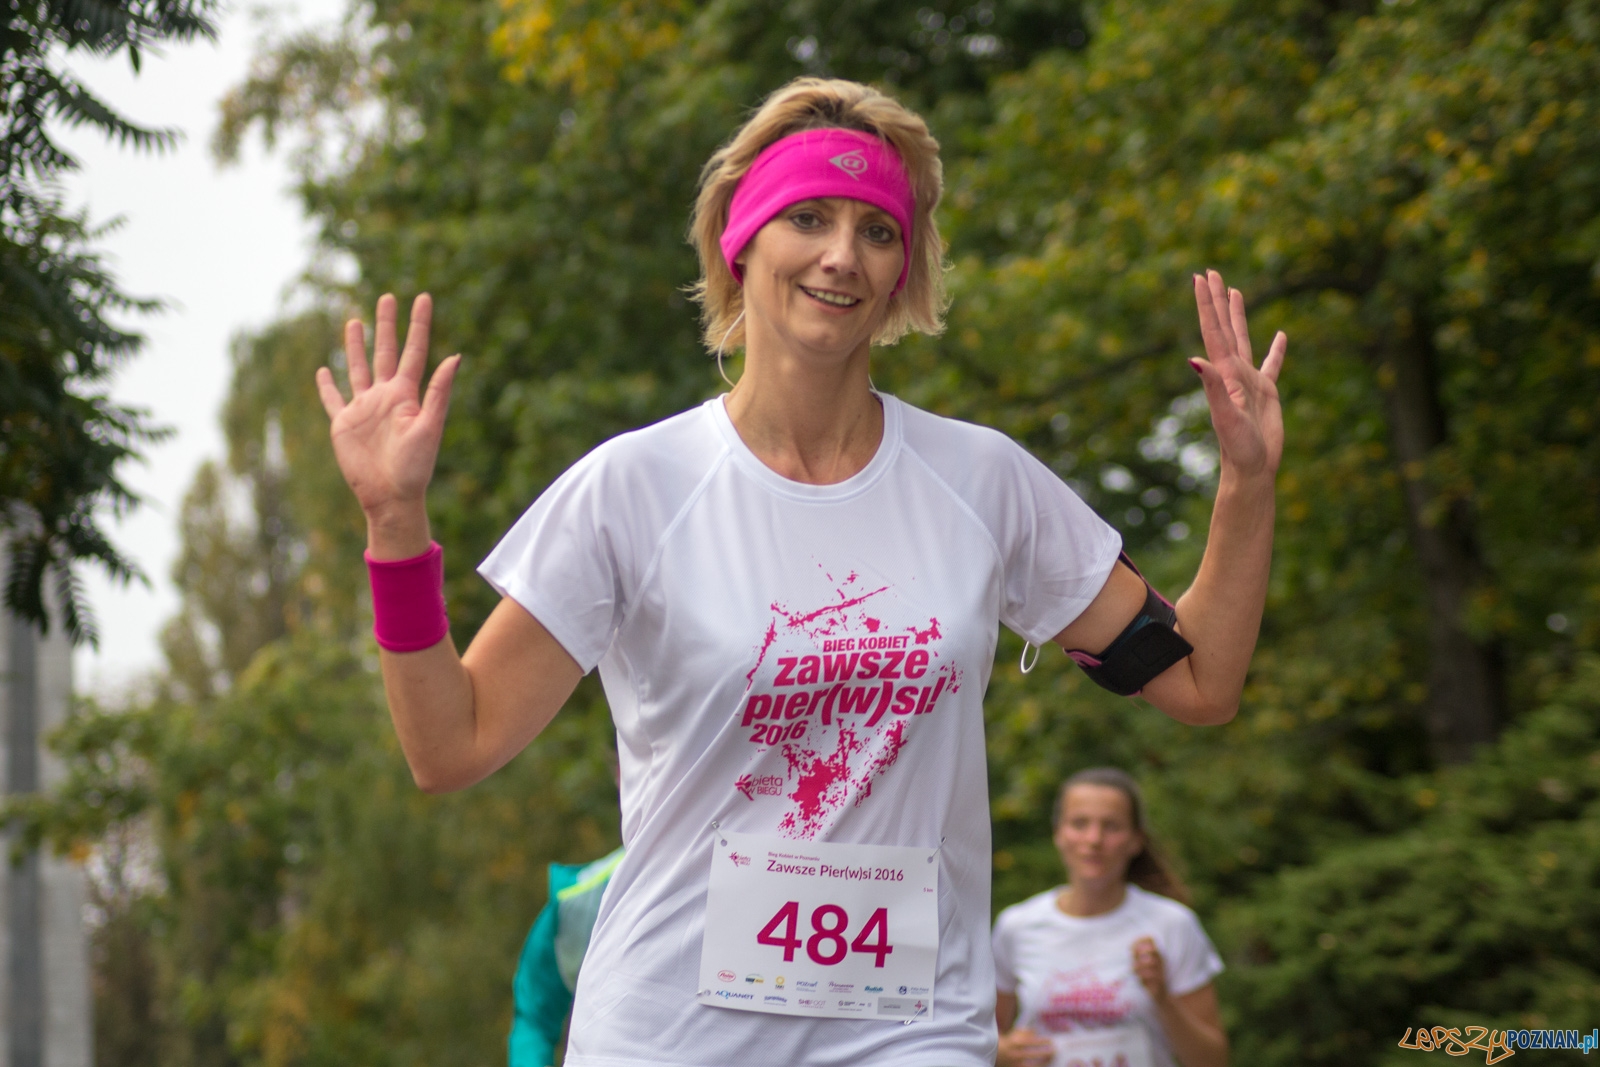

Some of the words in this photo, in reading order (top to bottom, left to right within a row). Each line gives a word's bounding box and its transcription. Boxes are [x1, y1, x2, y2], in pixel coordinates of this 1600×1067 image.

[823, 639, 856, 652] BIEG
[858, 636, 910, 650] KOBIET
[773, 650, 929, 687] zawsze
[741, 677, 947, 728] pier(w)si!
[749, 720, 809, 746] 2016
[756, 786, 783, 796] BIEGU
[766, 859, 816, 876] Zawsze
[819, 864, 872, 881] Pier(w)si
[874, 868, 905, 882] 2016
[756, 900, 894, 968] 484
